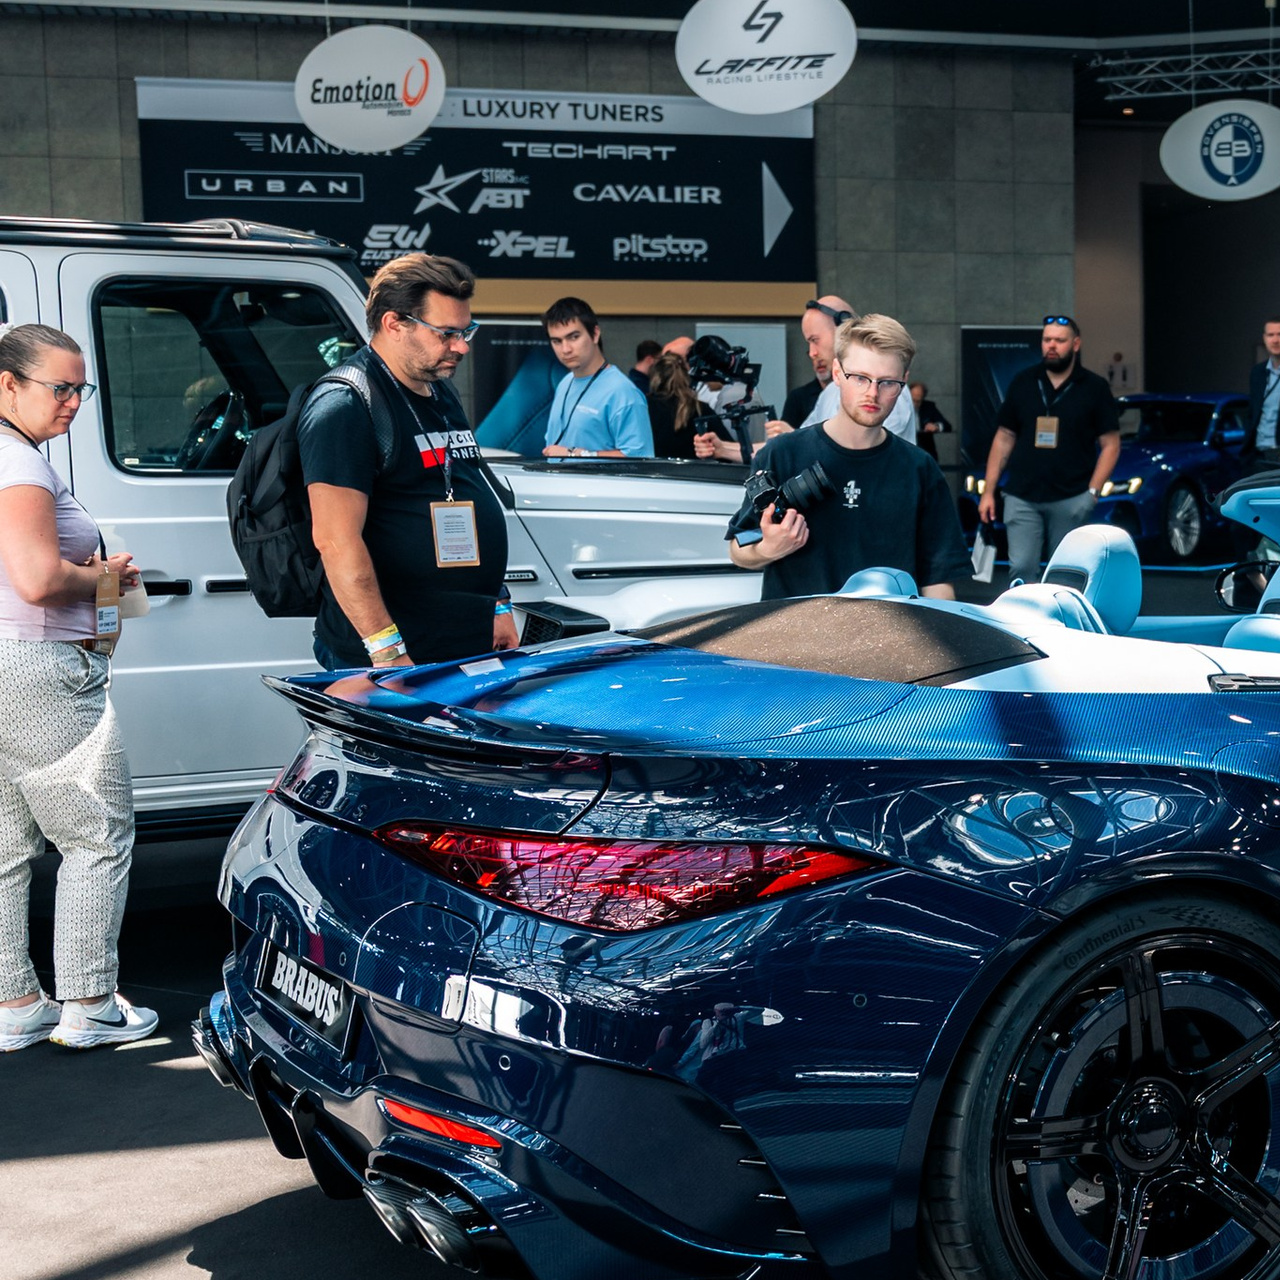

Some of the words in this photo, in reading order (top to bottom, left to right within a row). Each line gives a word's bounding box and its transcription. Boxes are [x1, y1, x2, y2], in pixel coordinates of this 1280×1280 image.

[694, 52, 837, 76] LAFFITE
[311, 76, 398, 104] Emotion
[706, 75, 753, 86] RACING
[756, 70, 824, 83] LIFESTYLE
[462, 99, 560, 120] LUXURY
[568, 102, 665, 123] TUNERS
[502, 141, 677, 162] TECHART
[201, 177, 349, 195] URBAN
[573, 182, 722, 205] CAVALIER
[467, 187, 531, 214] ABT
[489, 229, 576, 259] XPEL
[612, 233, 709, 259] pitstop
[271, 950, 340, 1027] BRABUS
